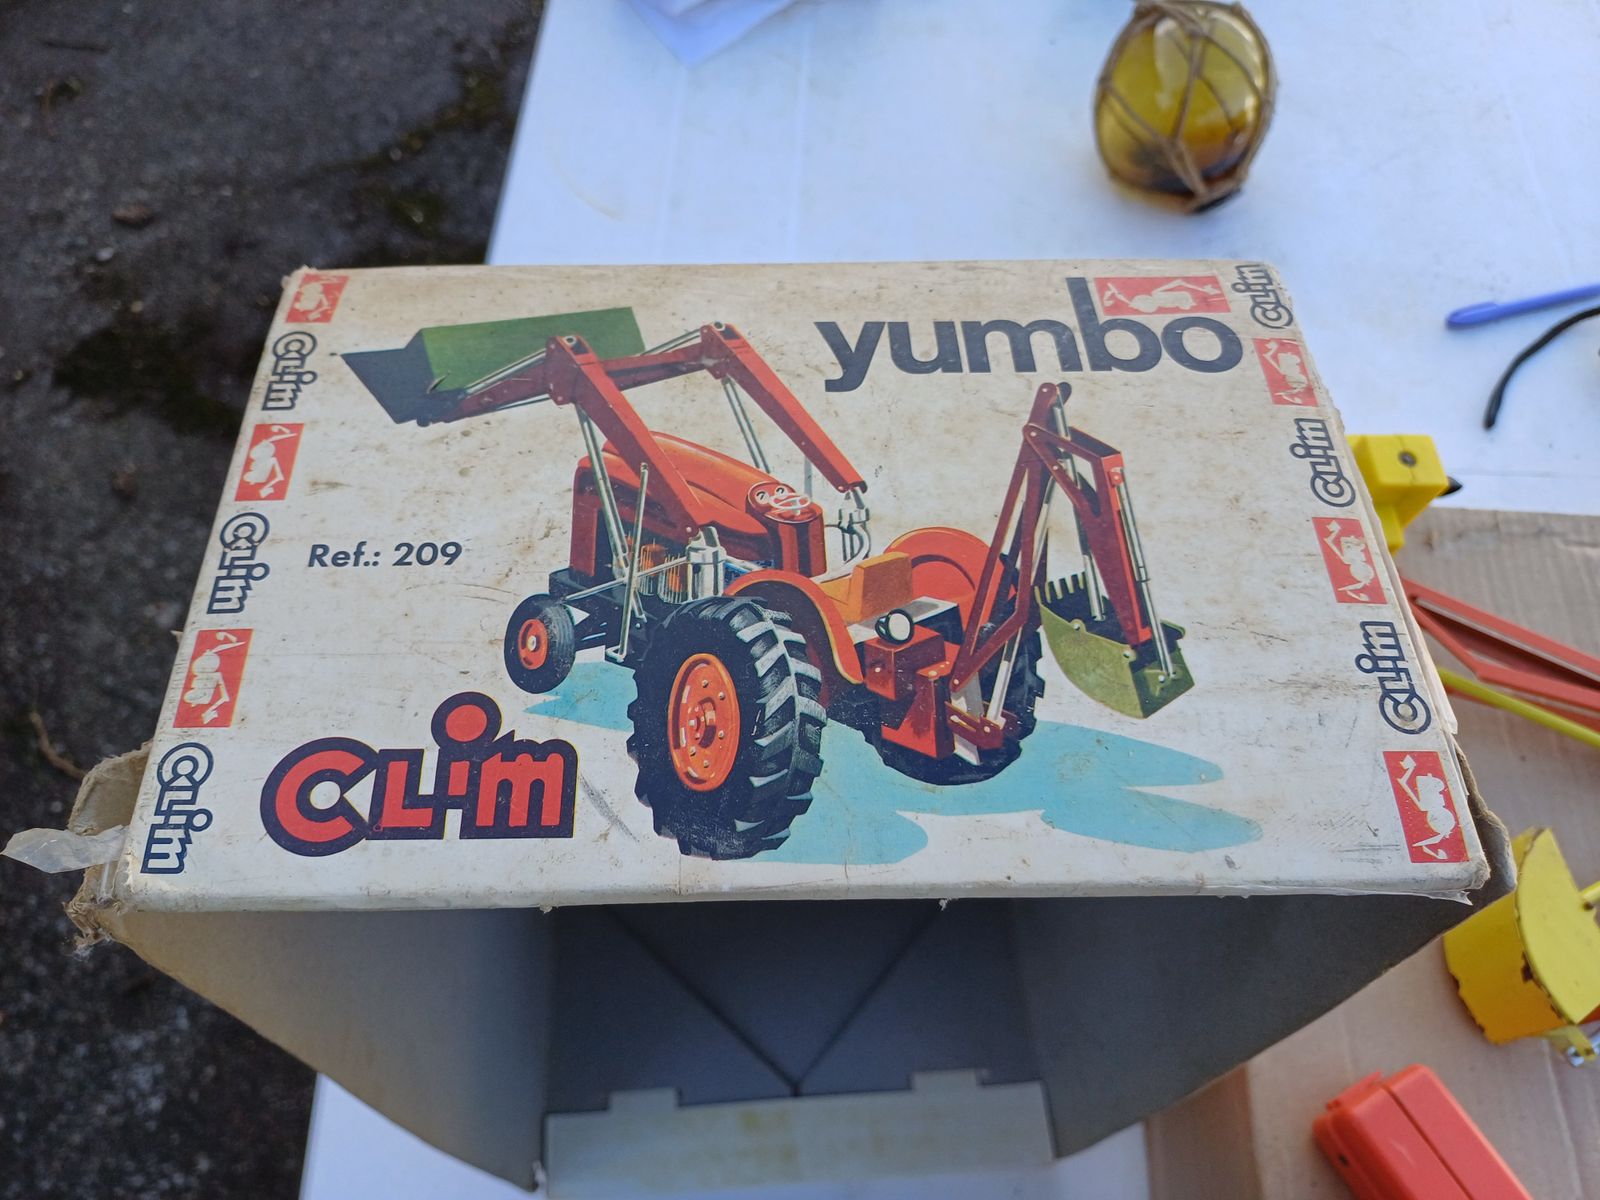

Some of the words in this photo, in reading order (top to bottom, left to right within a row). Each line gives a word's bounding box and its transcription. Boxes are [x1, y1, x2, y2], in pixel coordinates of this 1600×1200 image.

[814, 277, 1243, 392] yumbo
[308, 541, 380, 567] Ref.:
[392, 542, 463, 567] 209
